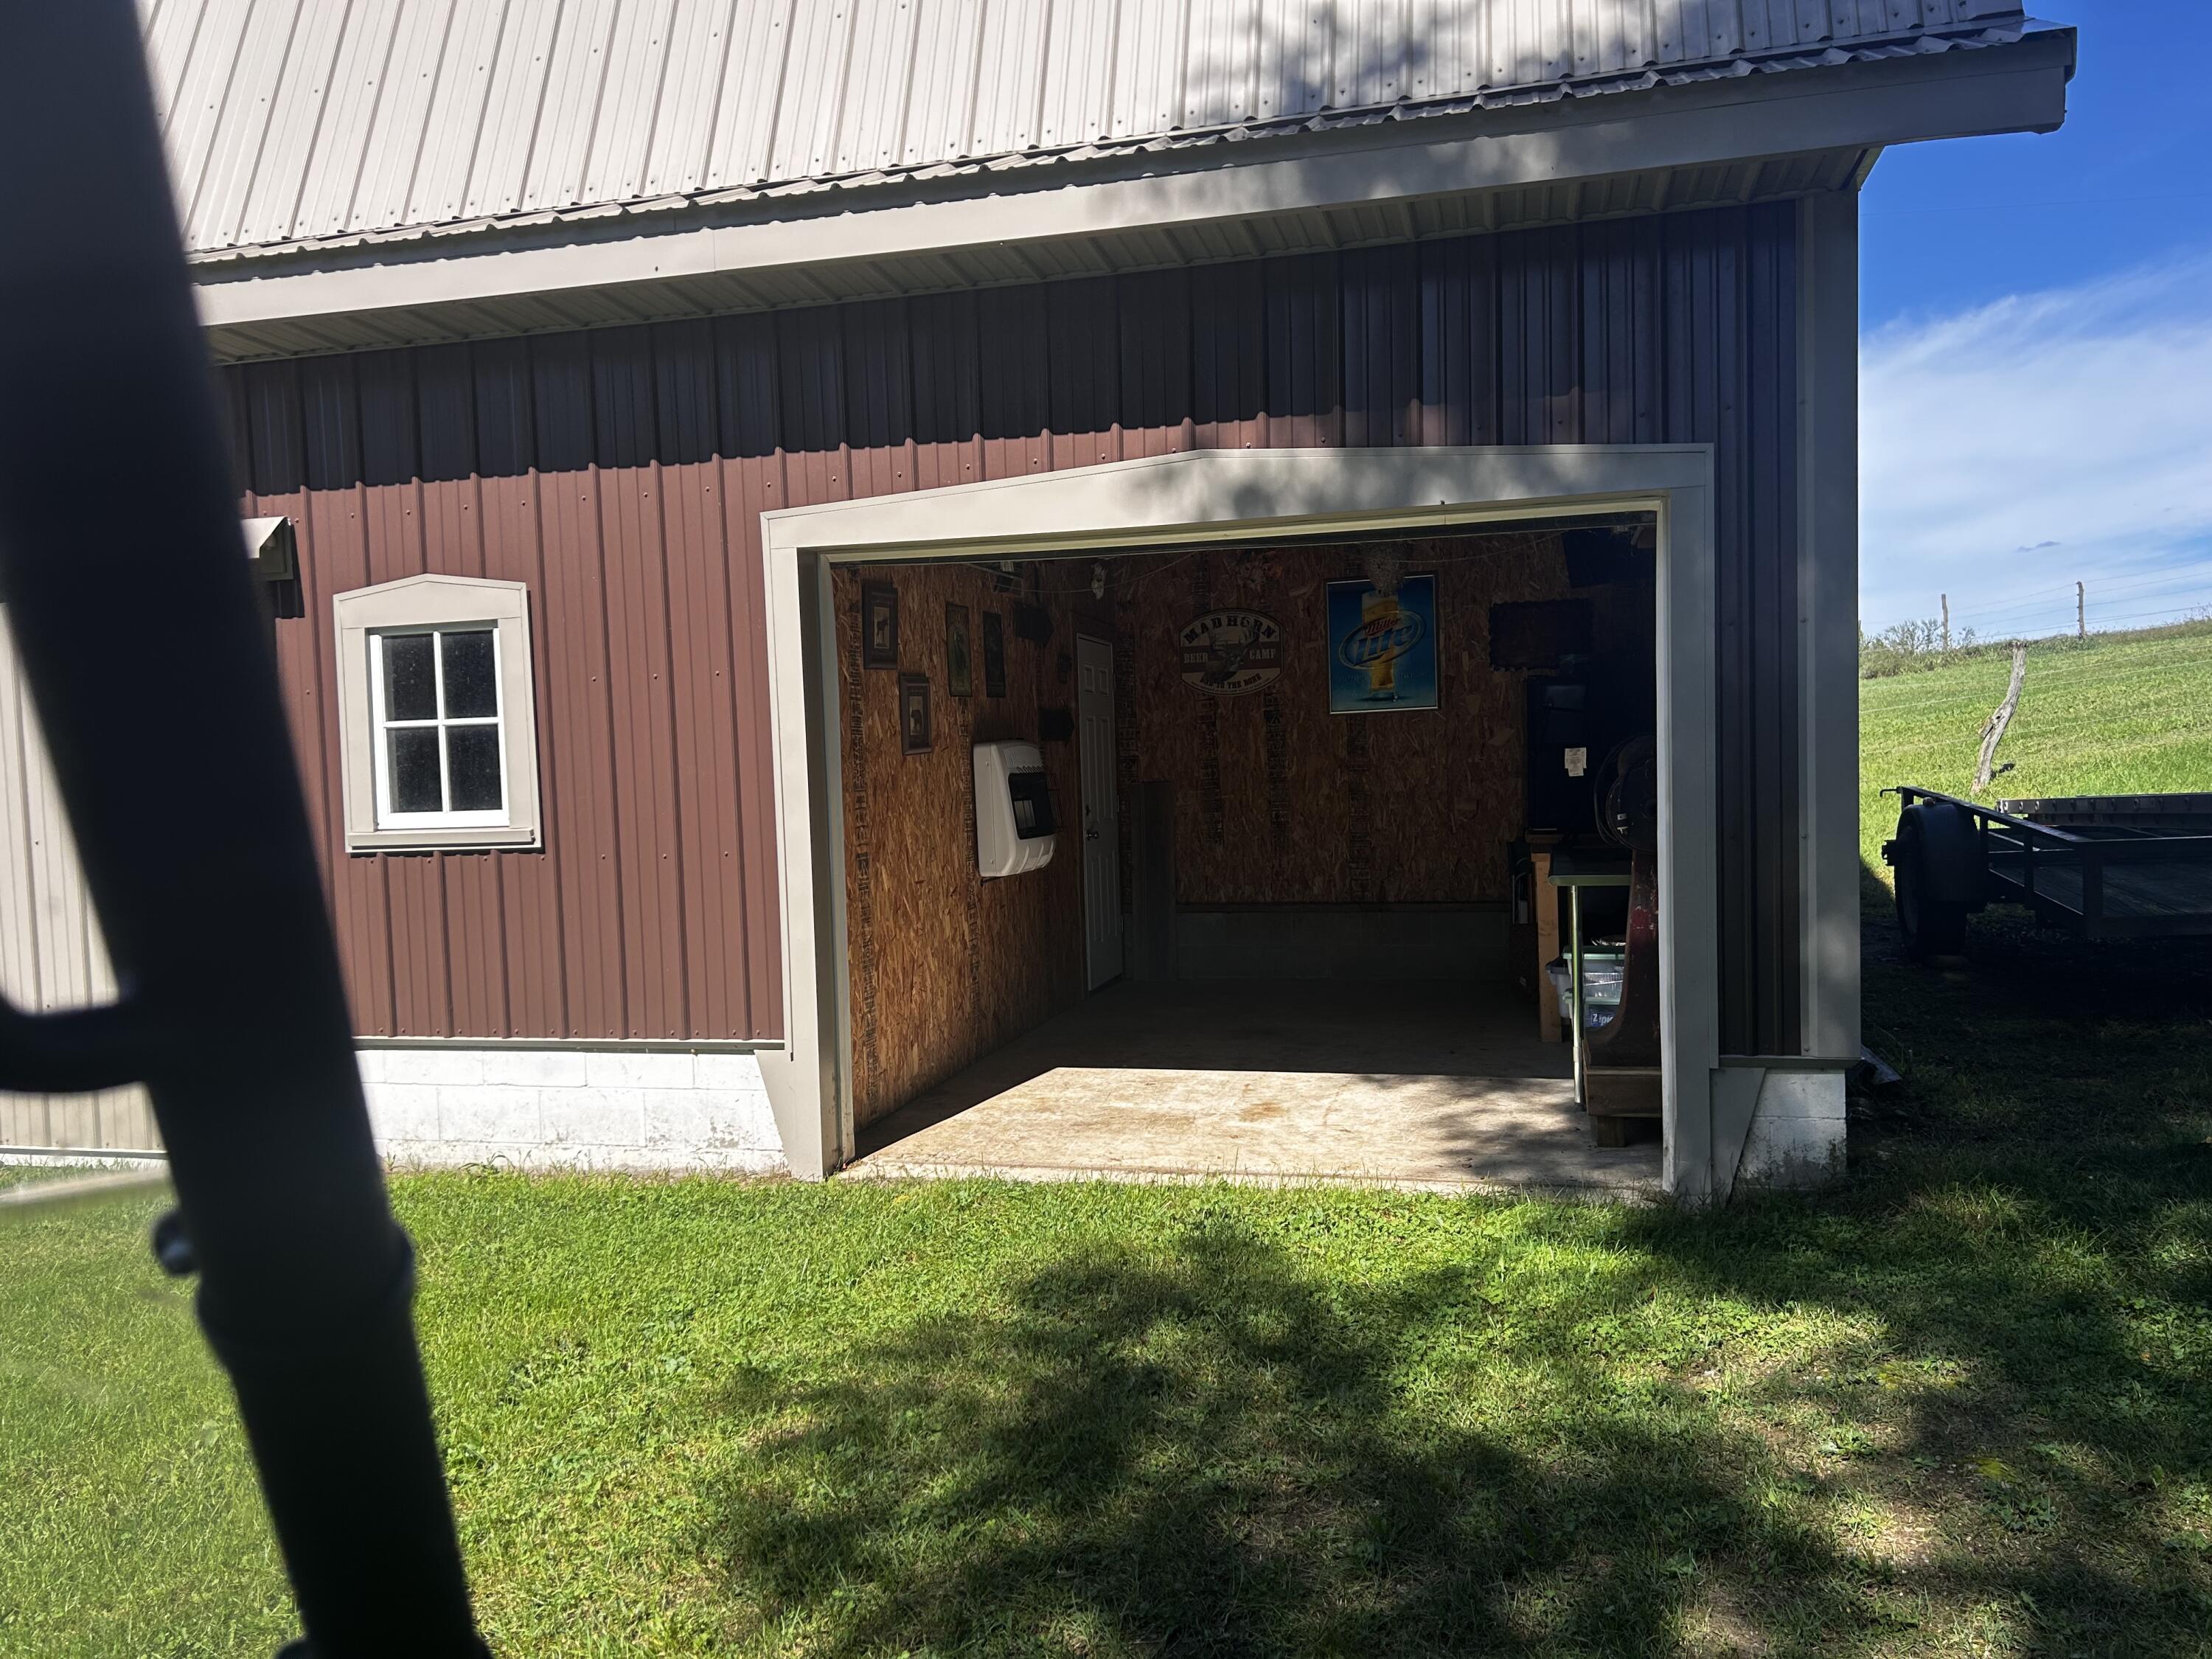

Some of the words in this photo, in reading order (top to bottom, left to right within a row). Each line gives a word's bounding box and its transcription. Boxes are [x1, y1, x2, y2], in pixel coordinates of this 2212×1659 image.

[1366, 618, 1402, 636] Miller
[1183, 652, 1208, 664] DEER
[1250, 648, 1276, 660] CAMP
[1227, 681, 1241, 689] THE
[1243, 672, 1262, 686] BONE
